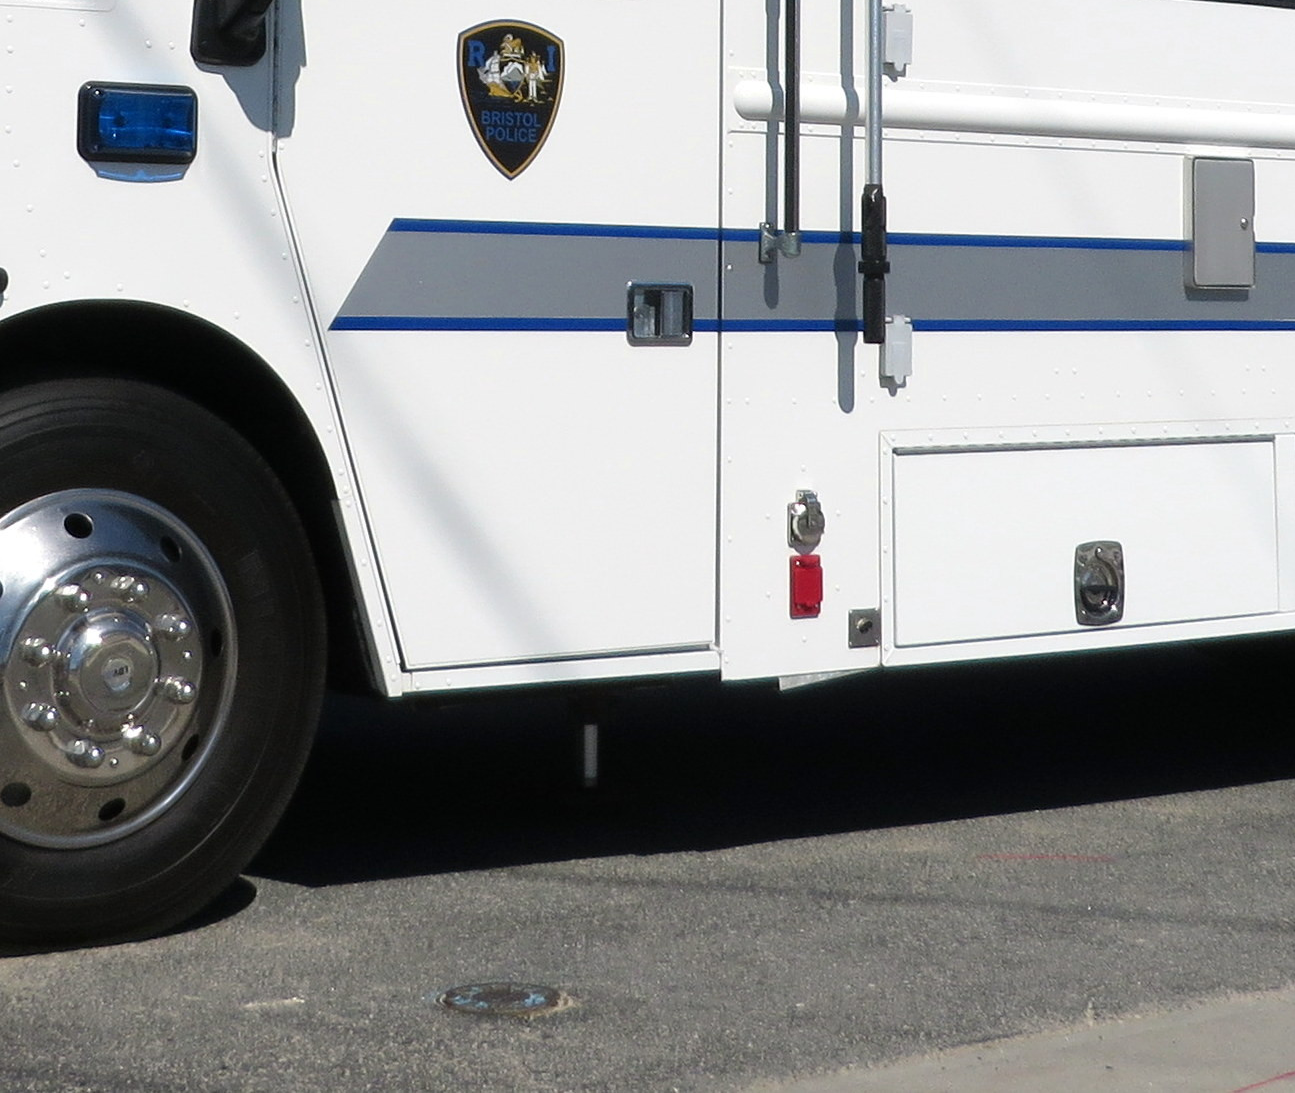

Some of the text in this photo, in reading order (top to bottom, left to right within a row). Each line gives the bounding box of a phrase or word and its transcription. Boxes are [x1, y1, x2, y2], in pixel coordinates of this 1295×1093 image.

[467, 39, 559, 72] R I
[481, 110, 542, 128] BRISTOL
[486, 126, 537, 143] POLICE
